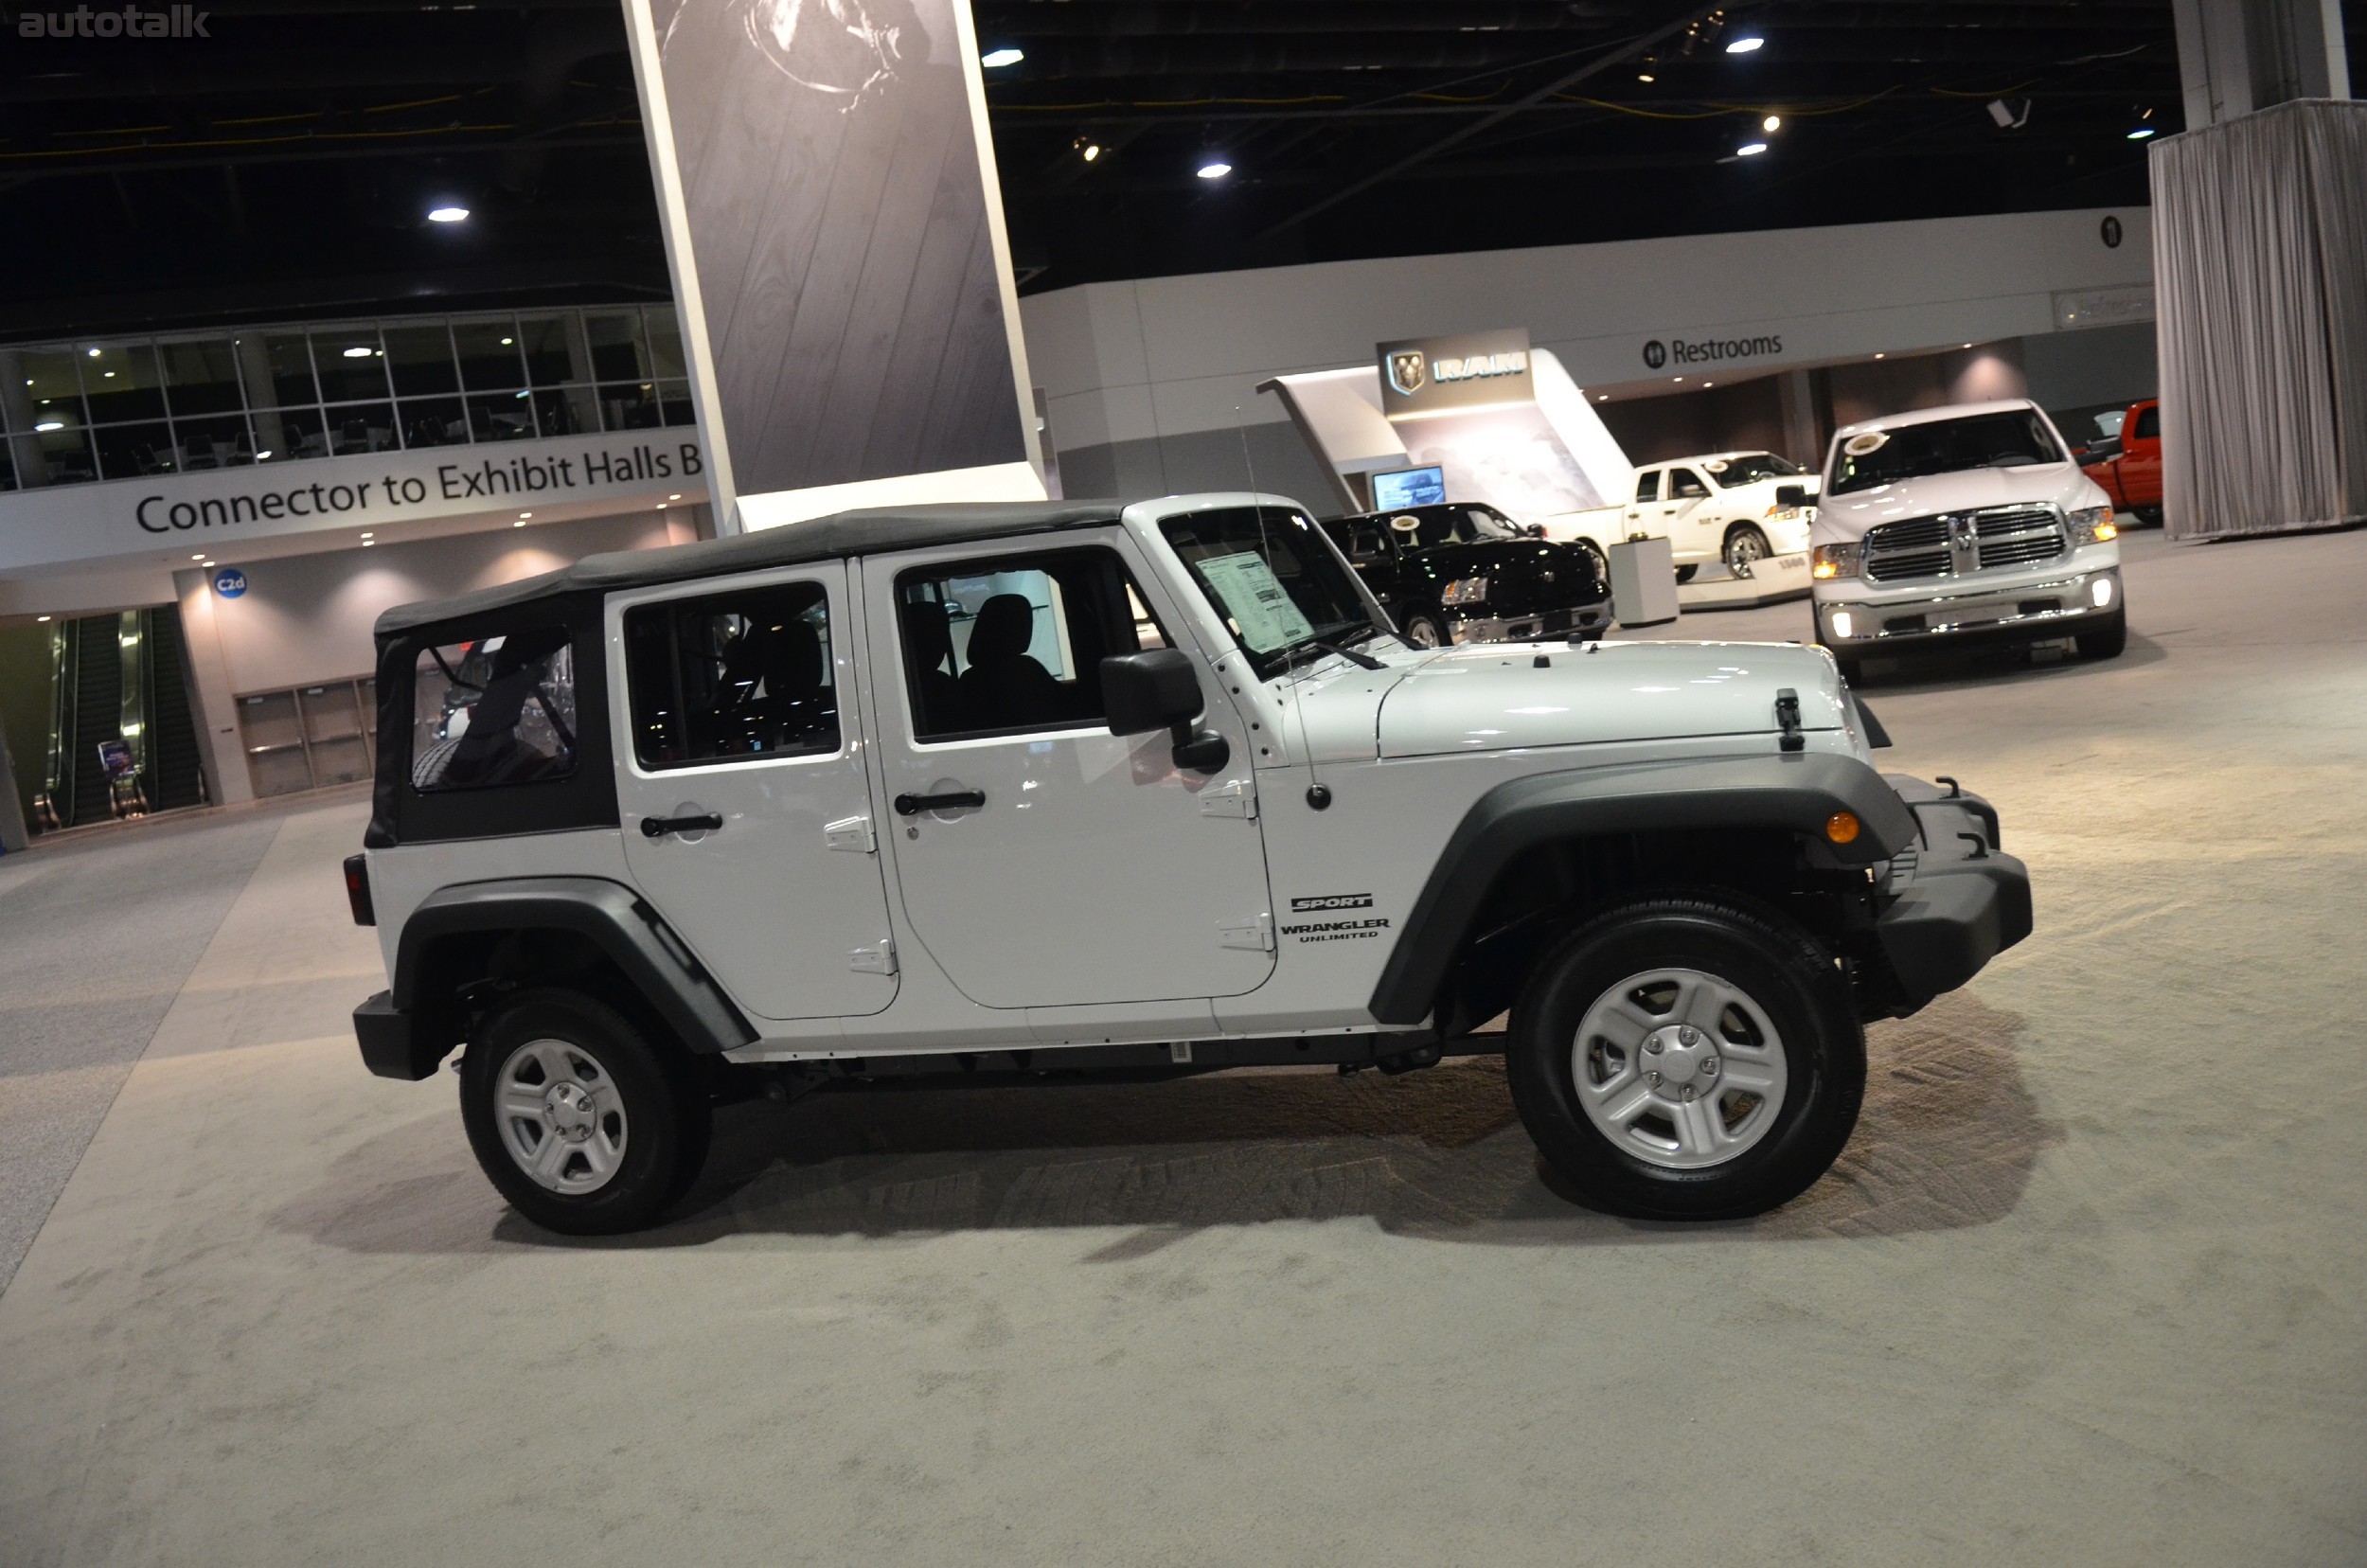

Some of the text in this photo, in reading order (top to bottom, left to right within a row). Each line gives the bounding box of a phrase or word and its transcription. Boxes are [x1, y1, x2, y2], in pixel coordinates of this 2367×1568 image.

[1672, 335, 1783, 365] Restrooms
[1433, 351, 1528, 383] RAM
[136, 442, 703, 534] Connector to Exhibit Halls B
[217, 576, 245, 592] C2d
[1295, 896, 1368, 910] SPORT
[1280, 918, 1391, 935] WRANGLER
[1299, 931, 1379, 944] UNLIMITED
